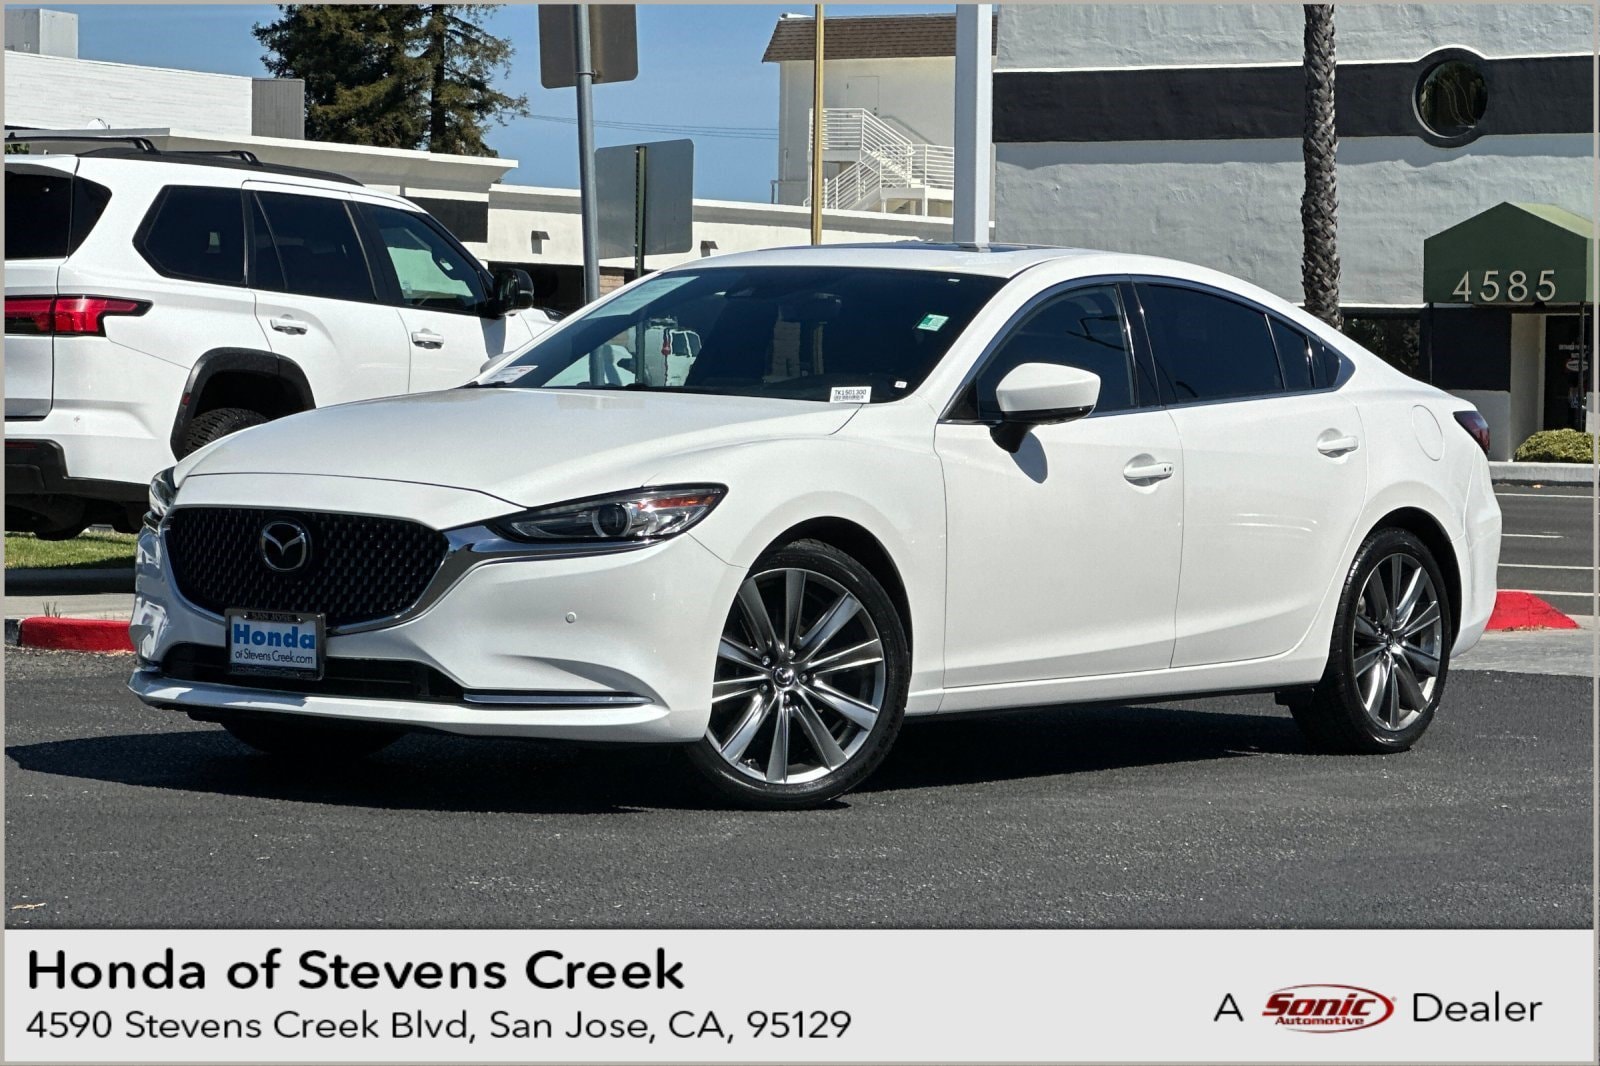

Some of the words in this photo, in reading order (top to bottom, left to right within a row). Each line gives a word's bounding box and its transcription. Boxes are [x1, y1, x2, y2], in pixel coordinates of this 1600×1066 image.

[1452, 269, 1556, 302] 4585
[233, 623, 315, 649] Honda
[235, 650, 243, 660] of
[243, 648, 271, 661] Stevens
